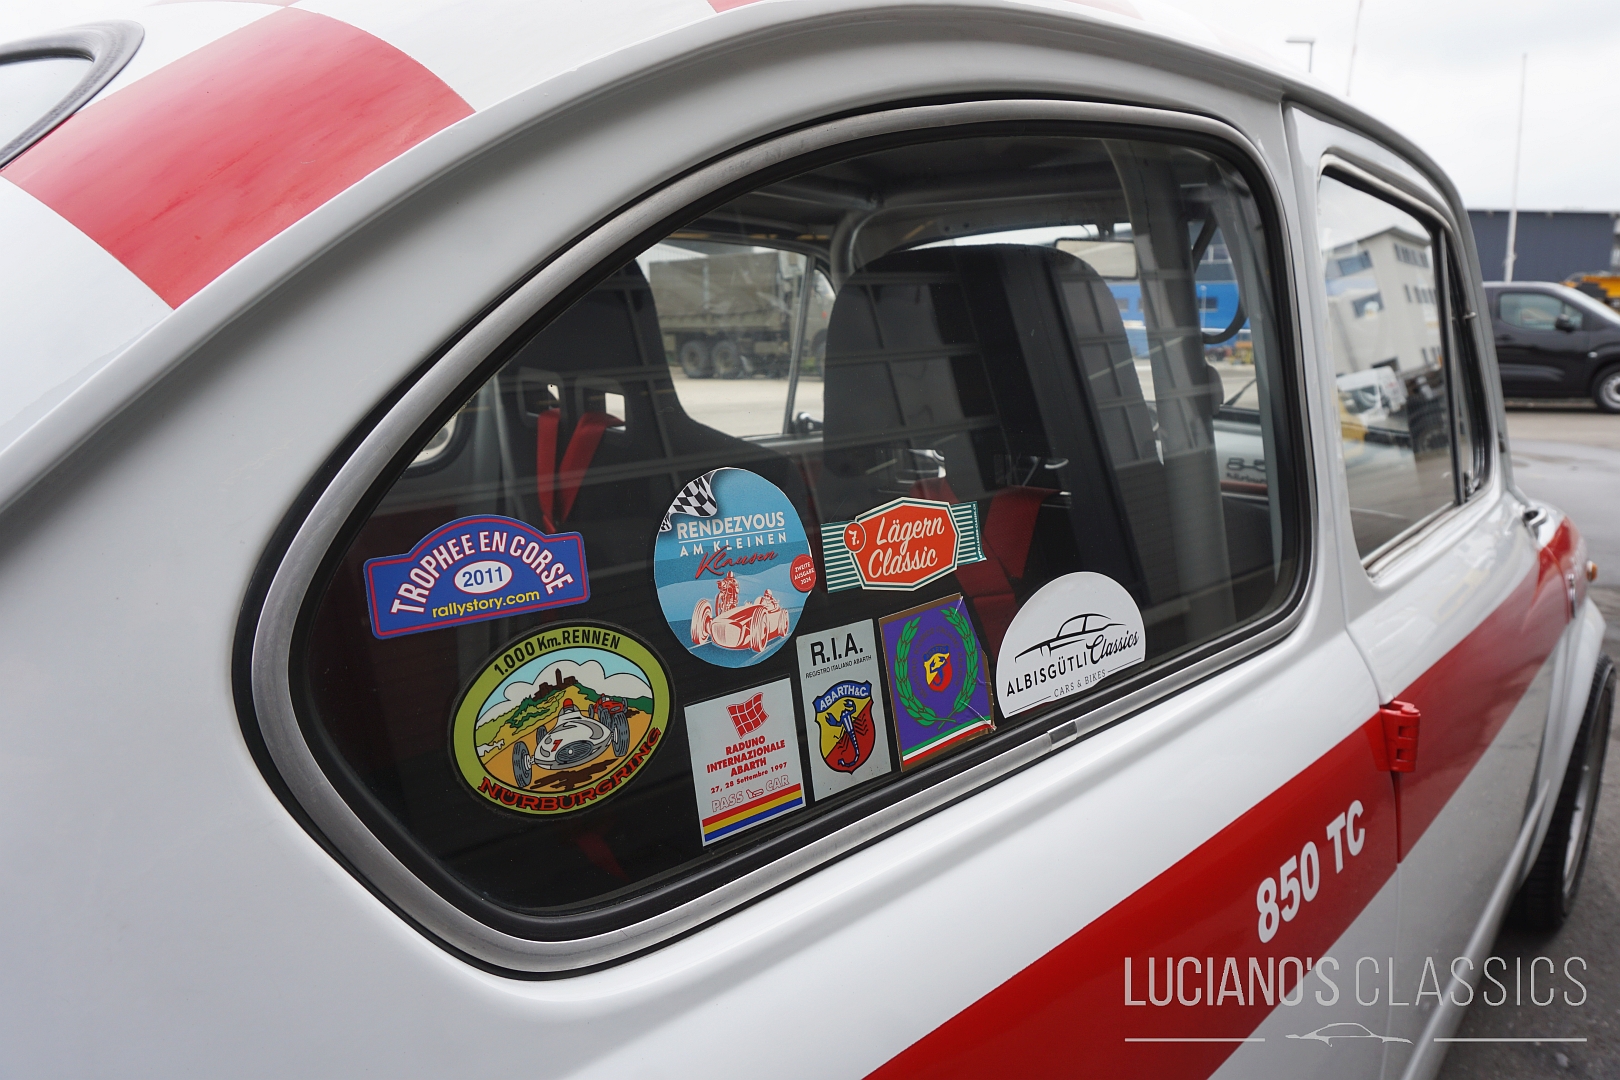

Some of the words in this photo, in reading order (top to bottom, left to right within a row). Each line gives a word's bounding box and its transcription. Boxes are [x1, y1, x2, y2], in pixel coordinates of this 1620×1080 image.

[676, 511, 786, 540] RENDEZVOUS
[848, 530, 860, 546] 7.
[876, 516, 945, 555] Lägern
[680, 543, 704, 557] AM
[713, 532, 787, 551] KLEINEN
[390, 533, 475, 614] TROPHEE
[479, 531, 508, 552] EN
[509, 535, 574, 595] CORSE
[462, 566, 503, 588] 2011
[695, 545, 778, 579] Klausen
[868, 546, 938, 579] Classic
[432, 591, 541, 618] rallystory.com
[494, 641, 535, 676] 1.000
[562, 629, 621, 650] RENNEN
[805, 667, 831, 679] REGISTRO
[831, 660, 853, 671] ITALIANO
[853, 655, 872, 665] ABARTH
[810, 633, 864, 667] R.I.A.
[1006, 651, 1087, 697] ALBISGÜTLI
[1085, 630, 1140, 665] Classics
[1053, 682, 1075, 698] CARS
[1076, 679, 1082, 688] &
[1084, 669, 1107, 685] BIKES
[706, 739, 786, 774] INTERNAZIONALE
[725, 735, 766, 756] RADUNO
[477, 726, 662, 812] NÜRBURGRING
[710, 785, 723, 795] 27,
[725, 780, 734, 789] 28
[736, 769, 769, 785] Settembre
[771, 761, 788, 773] 1997
[730, 756, 767, 778] ABARTH
[711, 790, 744, 812] PASS
[766, 774, 790, 791] CAR
[1256, 841, 1320, 943] 850
[1326, 800, 1366, 874] TC
